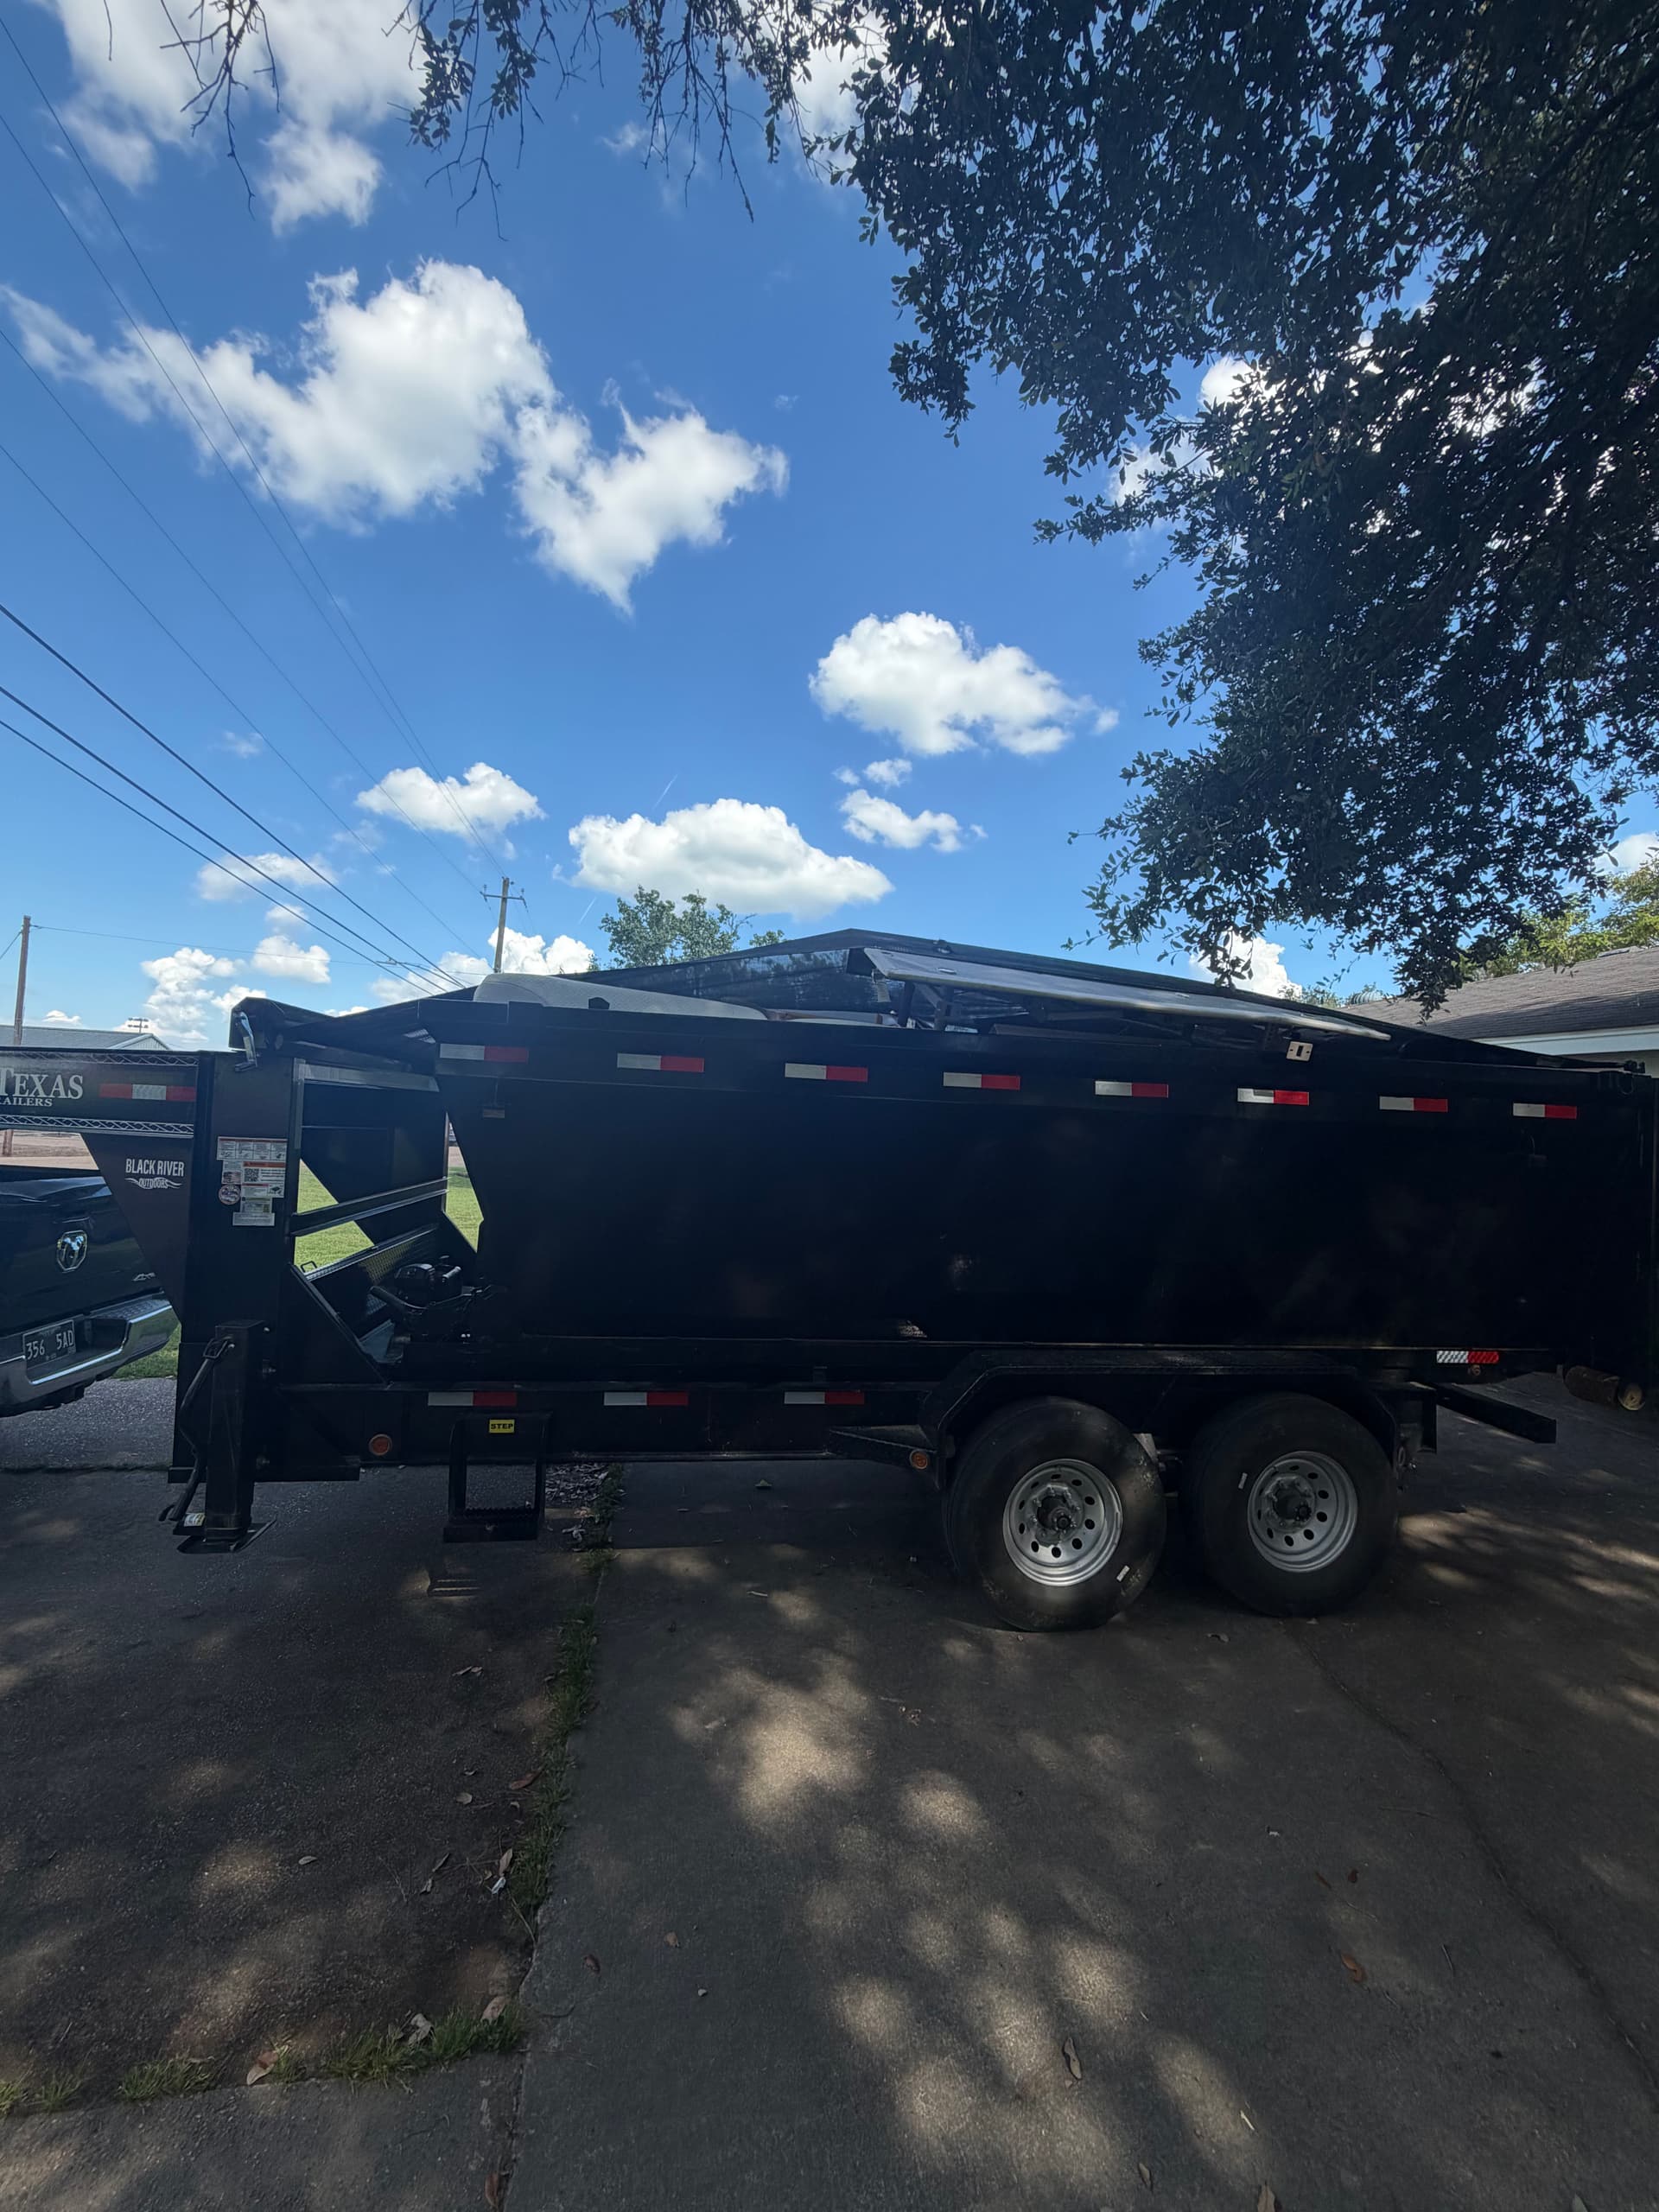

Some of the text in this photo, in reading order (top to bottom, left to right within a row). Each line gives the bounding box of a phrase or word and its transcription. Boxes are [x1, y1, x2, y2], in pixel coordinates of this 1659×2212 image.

[0, 1067, 84, 1099] TEXAS
[125, 1159, 185, 1177] BLACK RIVER
[138, 1178, 168, 1189] OUTDOORS
[26, 1339, 45, 1360] 356
[56, 1330, 74, 1350] 5AD
